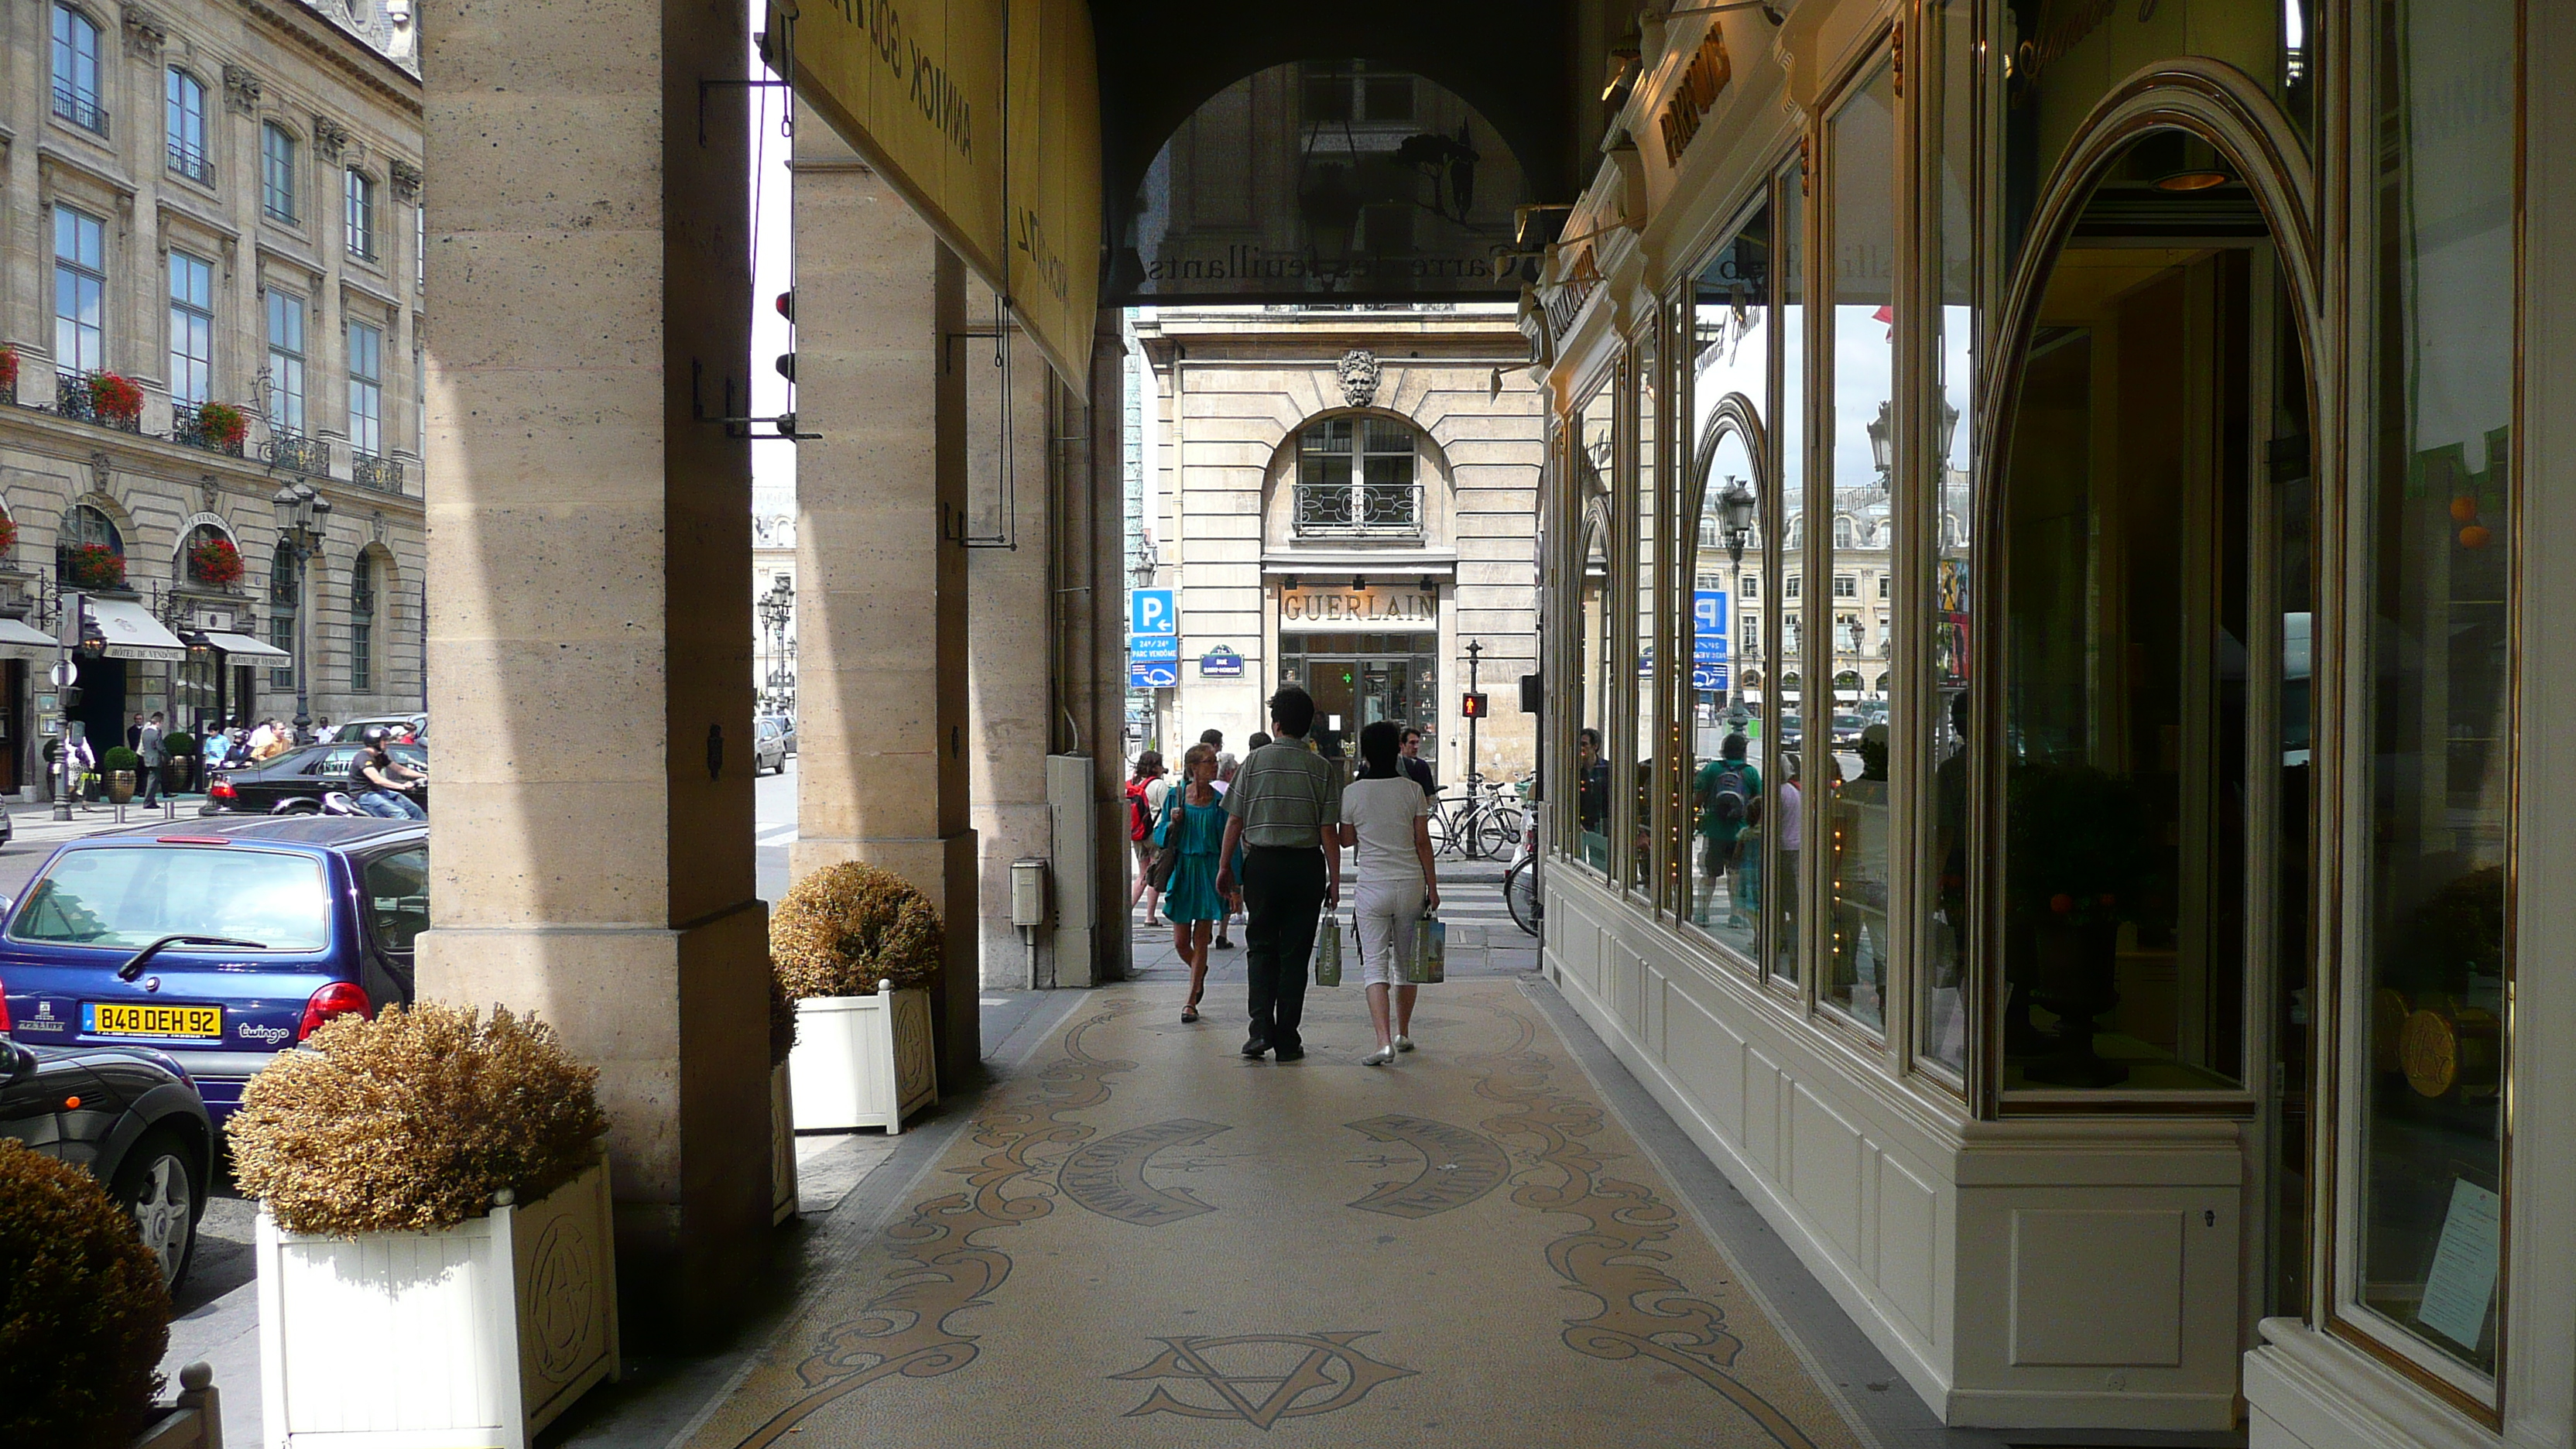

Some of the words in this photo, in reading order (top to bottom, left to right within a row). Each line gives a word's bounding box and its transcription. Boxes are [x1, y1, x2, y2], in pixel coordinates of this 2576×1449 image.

[1142, 597, 1163, 626] P
[1284, 594, 1437, 622] GUERLAIN
[111, 646, 133, 658] HÔTEL
[137, 649, 147, 659] DE
[149, 649, 180, 659] VENDÔME
[231, 655, 250, 665] HÔTEL
[1149, 649, 1177, 658] VENDÔME
[101, 1008, 140, 1030] 848
[145, 1009, 184, 1032] DEH
[190, 1010, 214, 1033] 92
[239, 1023, 289, 1045] twingo
